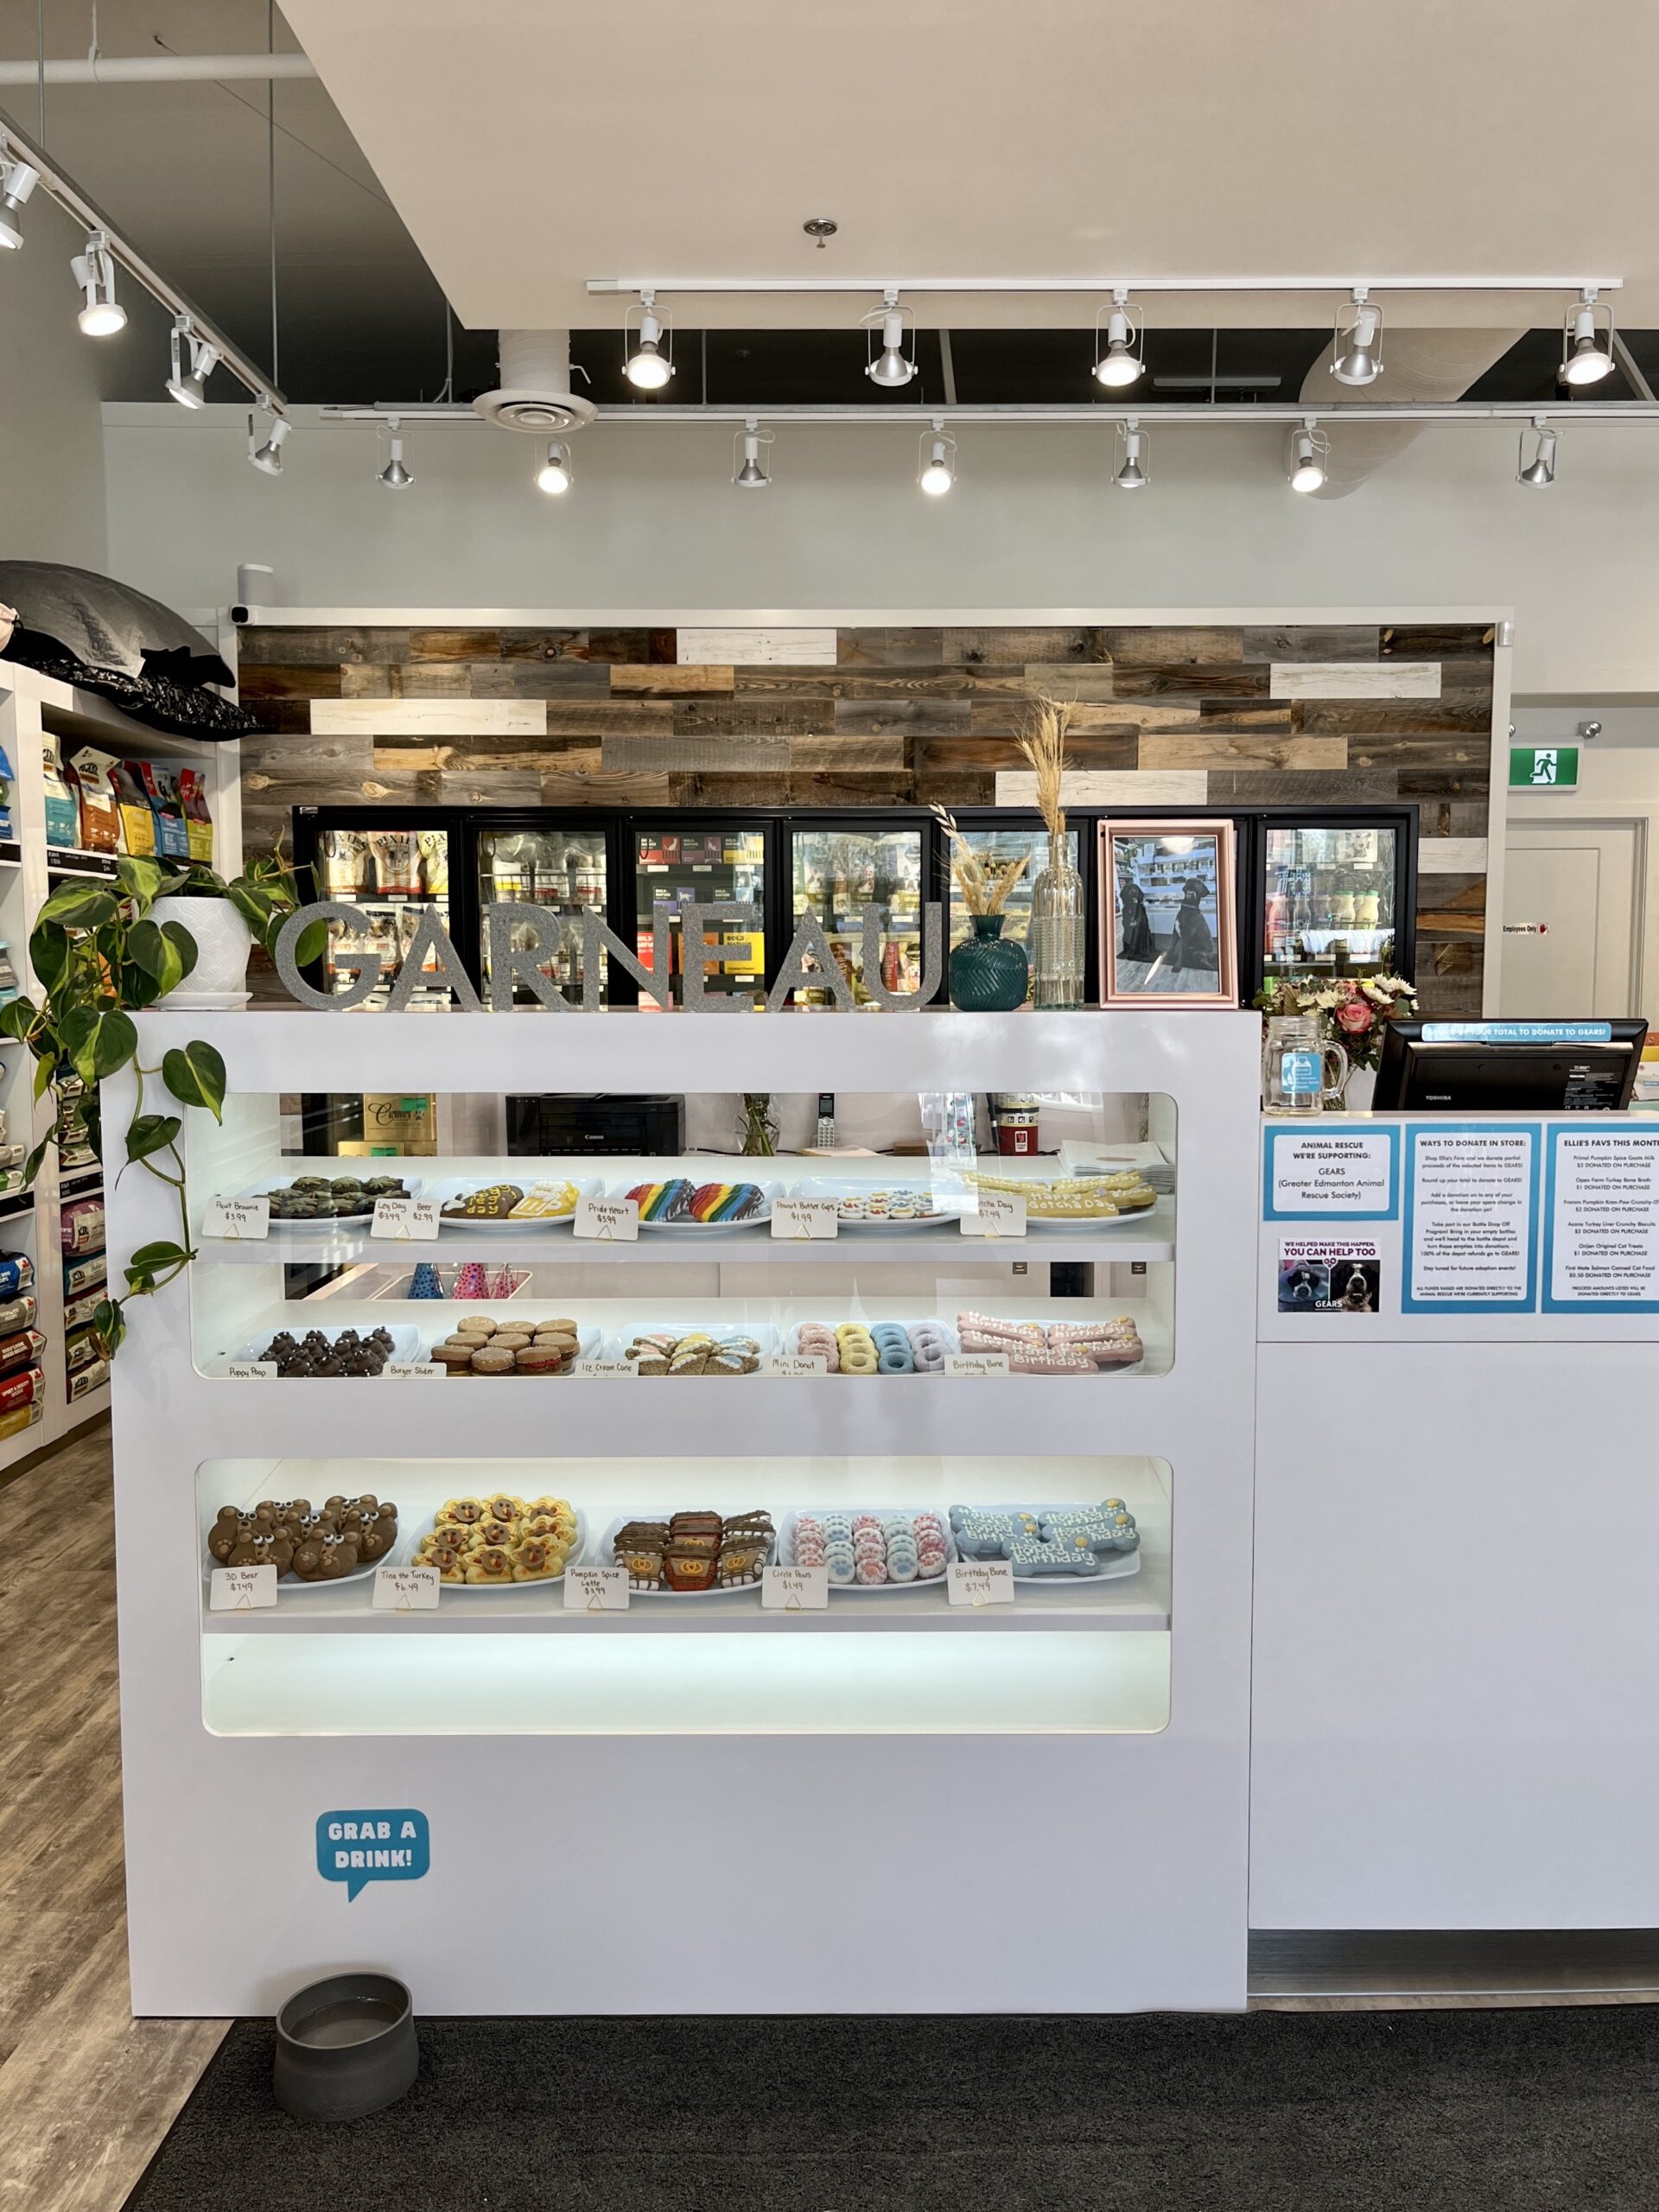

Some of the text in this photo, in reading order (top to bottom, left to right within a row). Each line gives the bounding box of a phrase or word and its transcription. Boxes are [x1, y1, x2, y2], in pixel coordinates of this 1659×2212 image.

[274, 901, 942, 1012] GARNEAU
[1279, 1179, 1312, 1189] (Greater
[470, 1195, 498, 1205] leg
[1031, 1192, 1081, 1201] Happy
[378, 1202, 406, 1212] Leg Day
[467, 1205, 498, 1215] day
[588, 1204, 607, 1213] Pride
[997, 1200, 1013, 1213] Day
[1029, 1200, 1116, 1211] Gotcha Day
[1012, 1344, 1066, 1356] Happy
[582, 1363, 592, 1371] Ice
[617, 1363, 632, 1371] Cone
[773, 1358, 815, 1369] Mini Donut
[953, 1359, 985, 1374] Birthday
[1014, 1355, 1089, 1369] Birthday
[229, 1367, 266, 1377] Puppy Poop
[391, 1365, 411, 1377] Burger
[1009, 1542, 1065, 1555] Happy
[1013, 1552, 1095, 1566] Birthday
[380, 1571, 396, 1580] Tina
[410, 1570, 434, 1586] Turkey
[571, 1569, 620, 1580] Pumpkin Spice
[795, 1569, 811, 1578] Paws
[956, 1567, 1007, 1580] Birthday Bone
[328, 1821, 416, 1840] GRAB A
[335, 1849, 412, 1868] DRINK!
